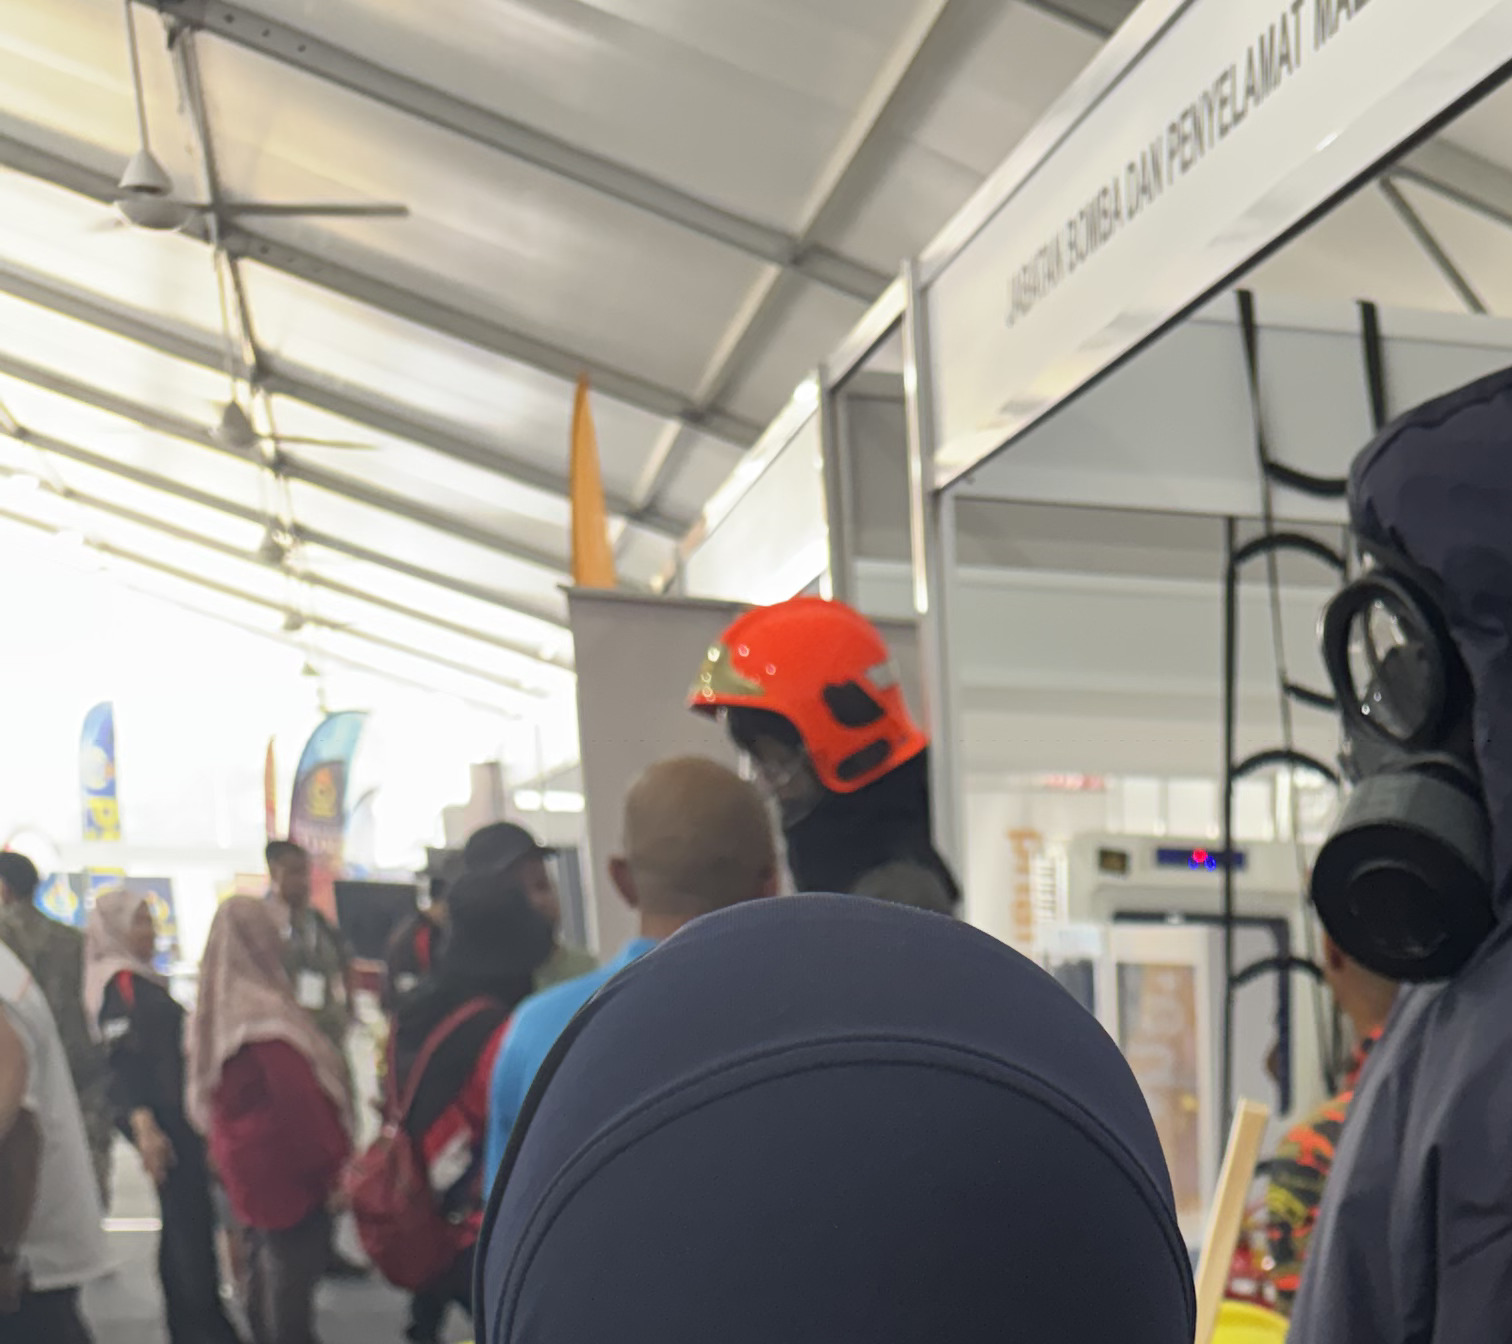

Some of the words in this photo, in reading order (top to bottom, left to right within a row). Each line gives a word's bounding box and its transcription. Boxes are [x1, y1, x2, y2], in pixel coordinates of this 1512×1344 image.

[1067, 177, 1125, 274] BOMBA
[1125, 136, 1163, 221] DAN
[1166, 3, 1301, 185] PENYELAMAT
